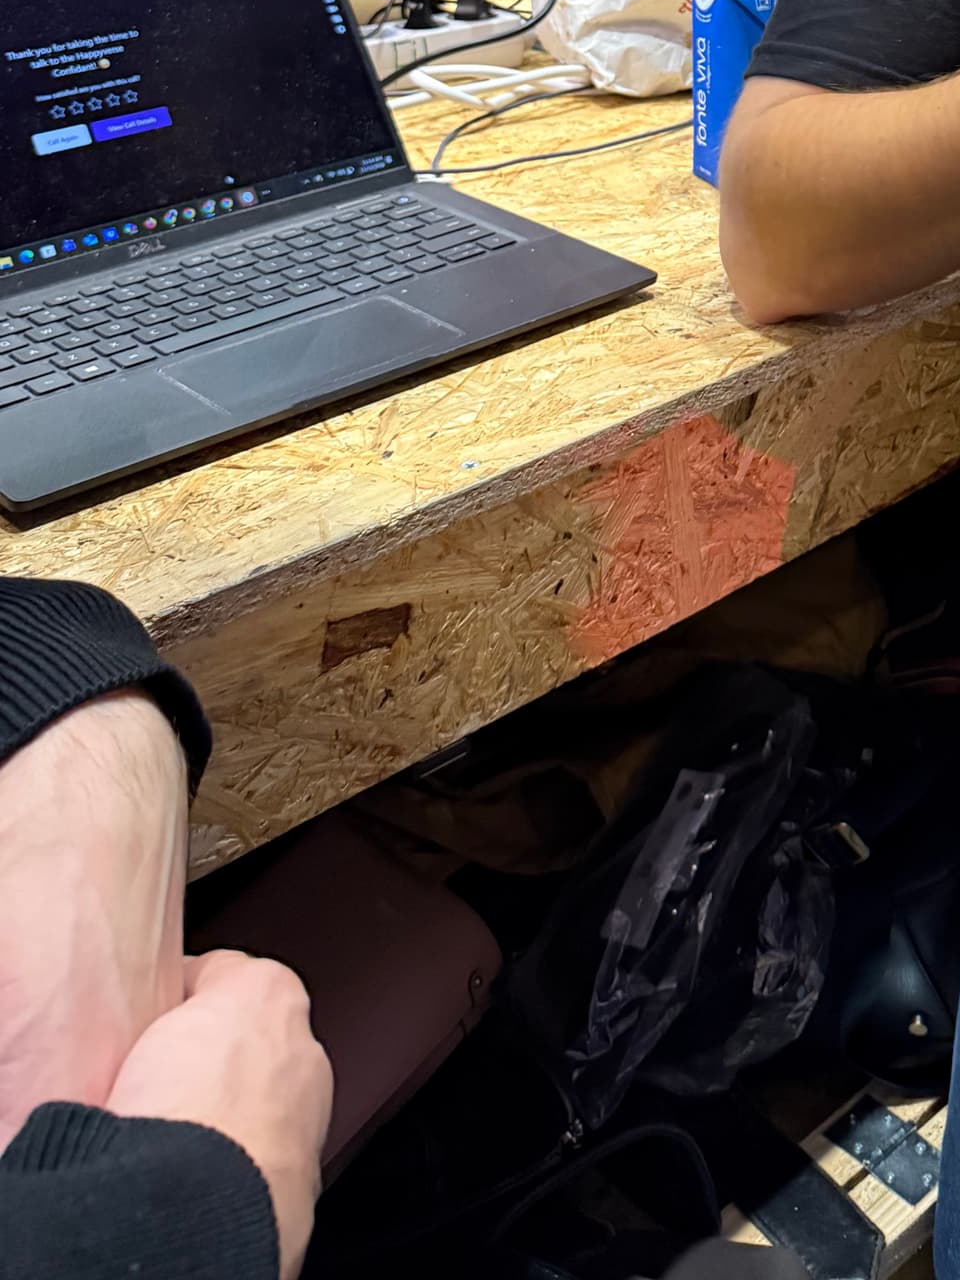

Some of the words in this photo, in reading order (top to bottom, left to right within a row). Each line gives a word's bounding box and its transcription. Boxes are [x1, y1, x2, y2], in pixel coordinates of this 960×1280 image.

[4, 48, 35, 61] Thank
[34, 45, 52, 58] you
[51, 42, 67, 53] for
[66, 37, 95, 51] taking
[94, 34, 109, 45] the
[109, 31, 129, 42] time
[128, 29, 140, 39] to
[30, 58, 50, 70] talk
[49, 57, 60, 66] to
[60, 53, 75, 64] the
[695, 36, 707, 83] viva
[695, 89, 707, 147] fonte
